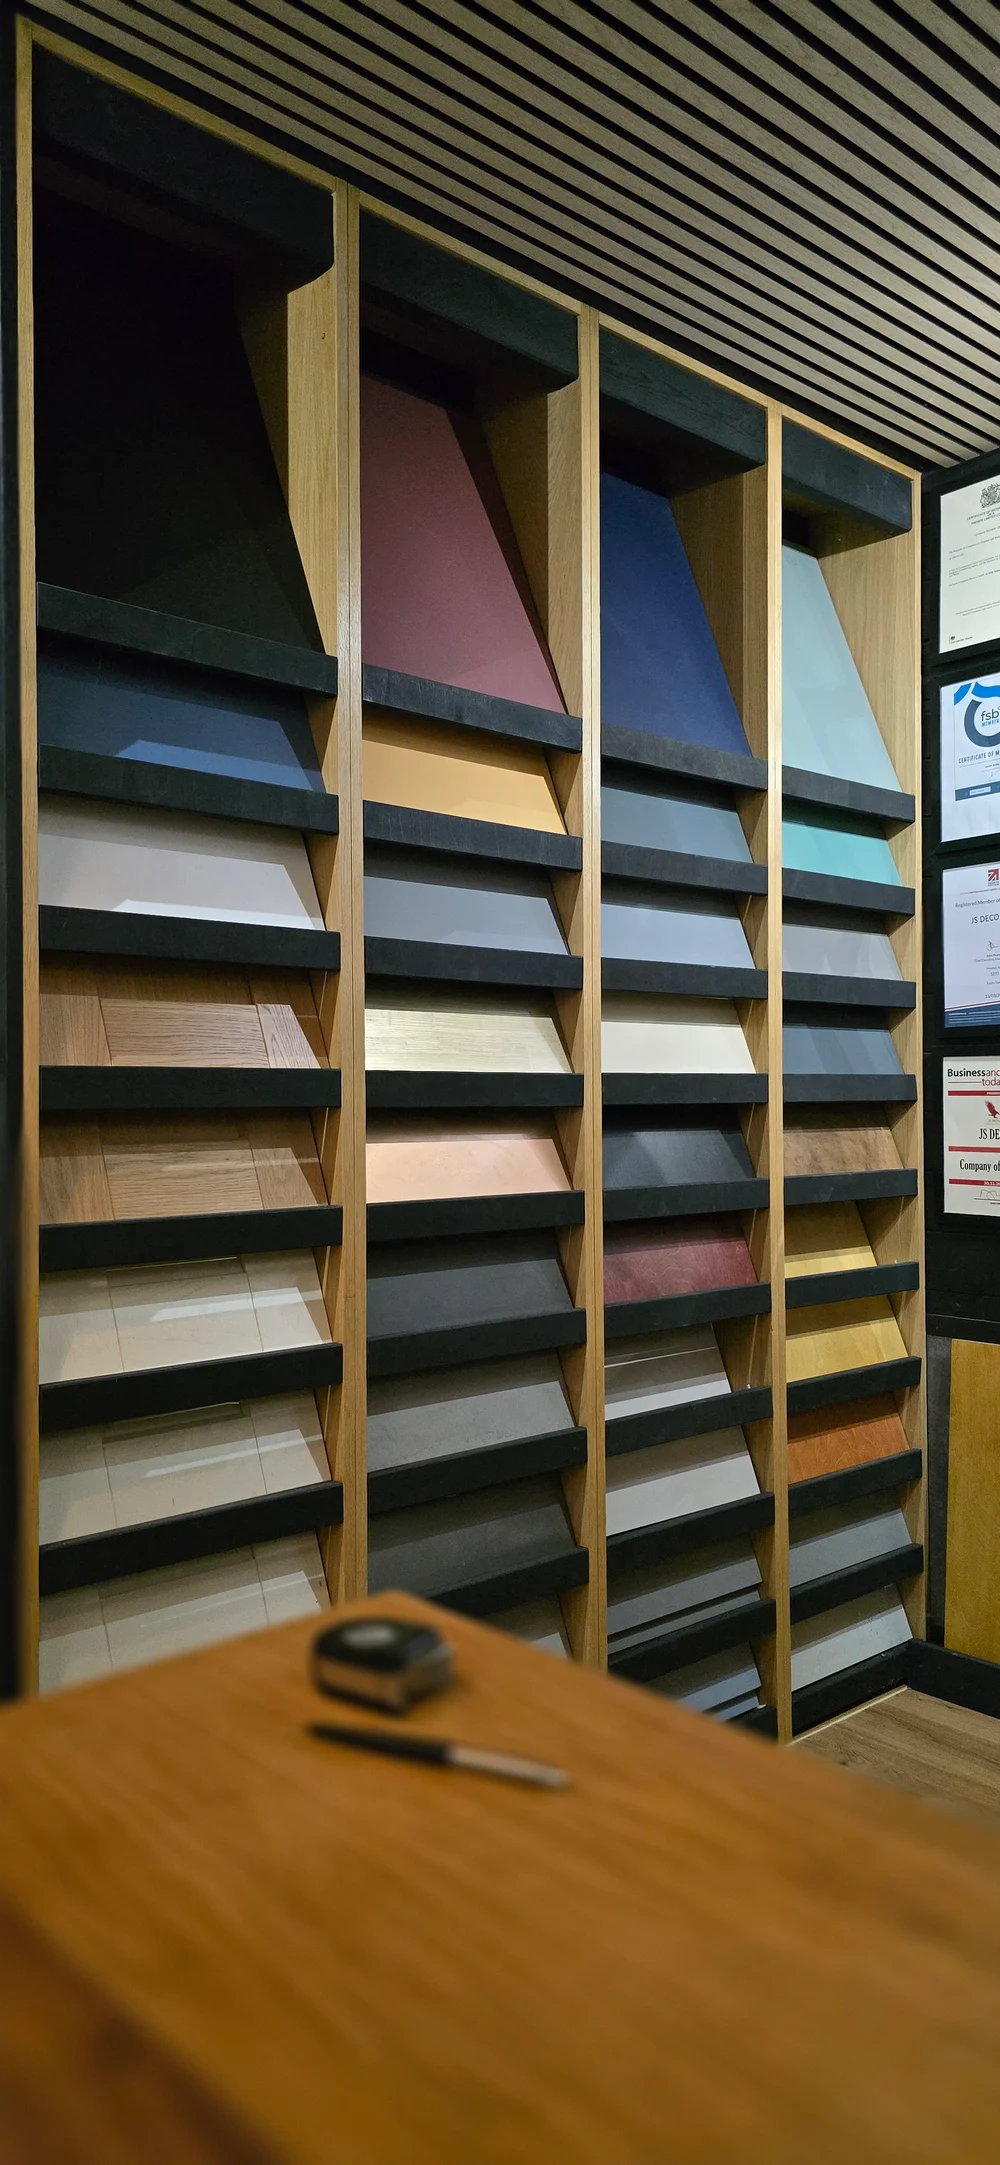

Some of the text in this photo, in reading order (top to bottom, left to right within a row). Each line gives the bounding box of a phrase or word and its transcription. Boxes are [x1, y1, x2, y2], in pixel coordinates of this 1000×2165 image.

[981, 708, 1000, 722] fsb
[958, 752, 987, 764] CERTIFICATE
[971, 913, 1000, 925] JS DECO
[978, 1128, 1000, 1140] JS DE
[959, 1158, 991, 1173] Company
